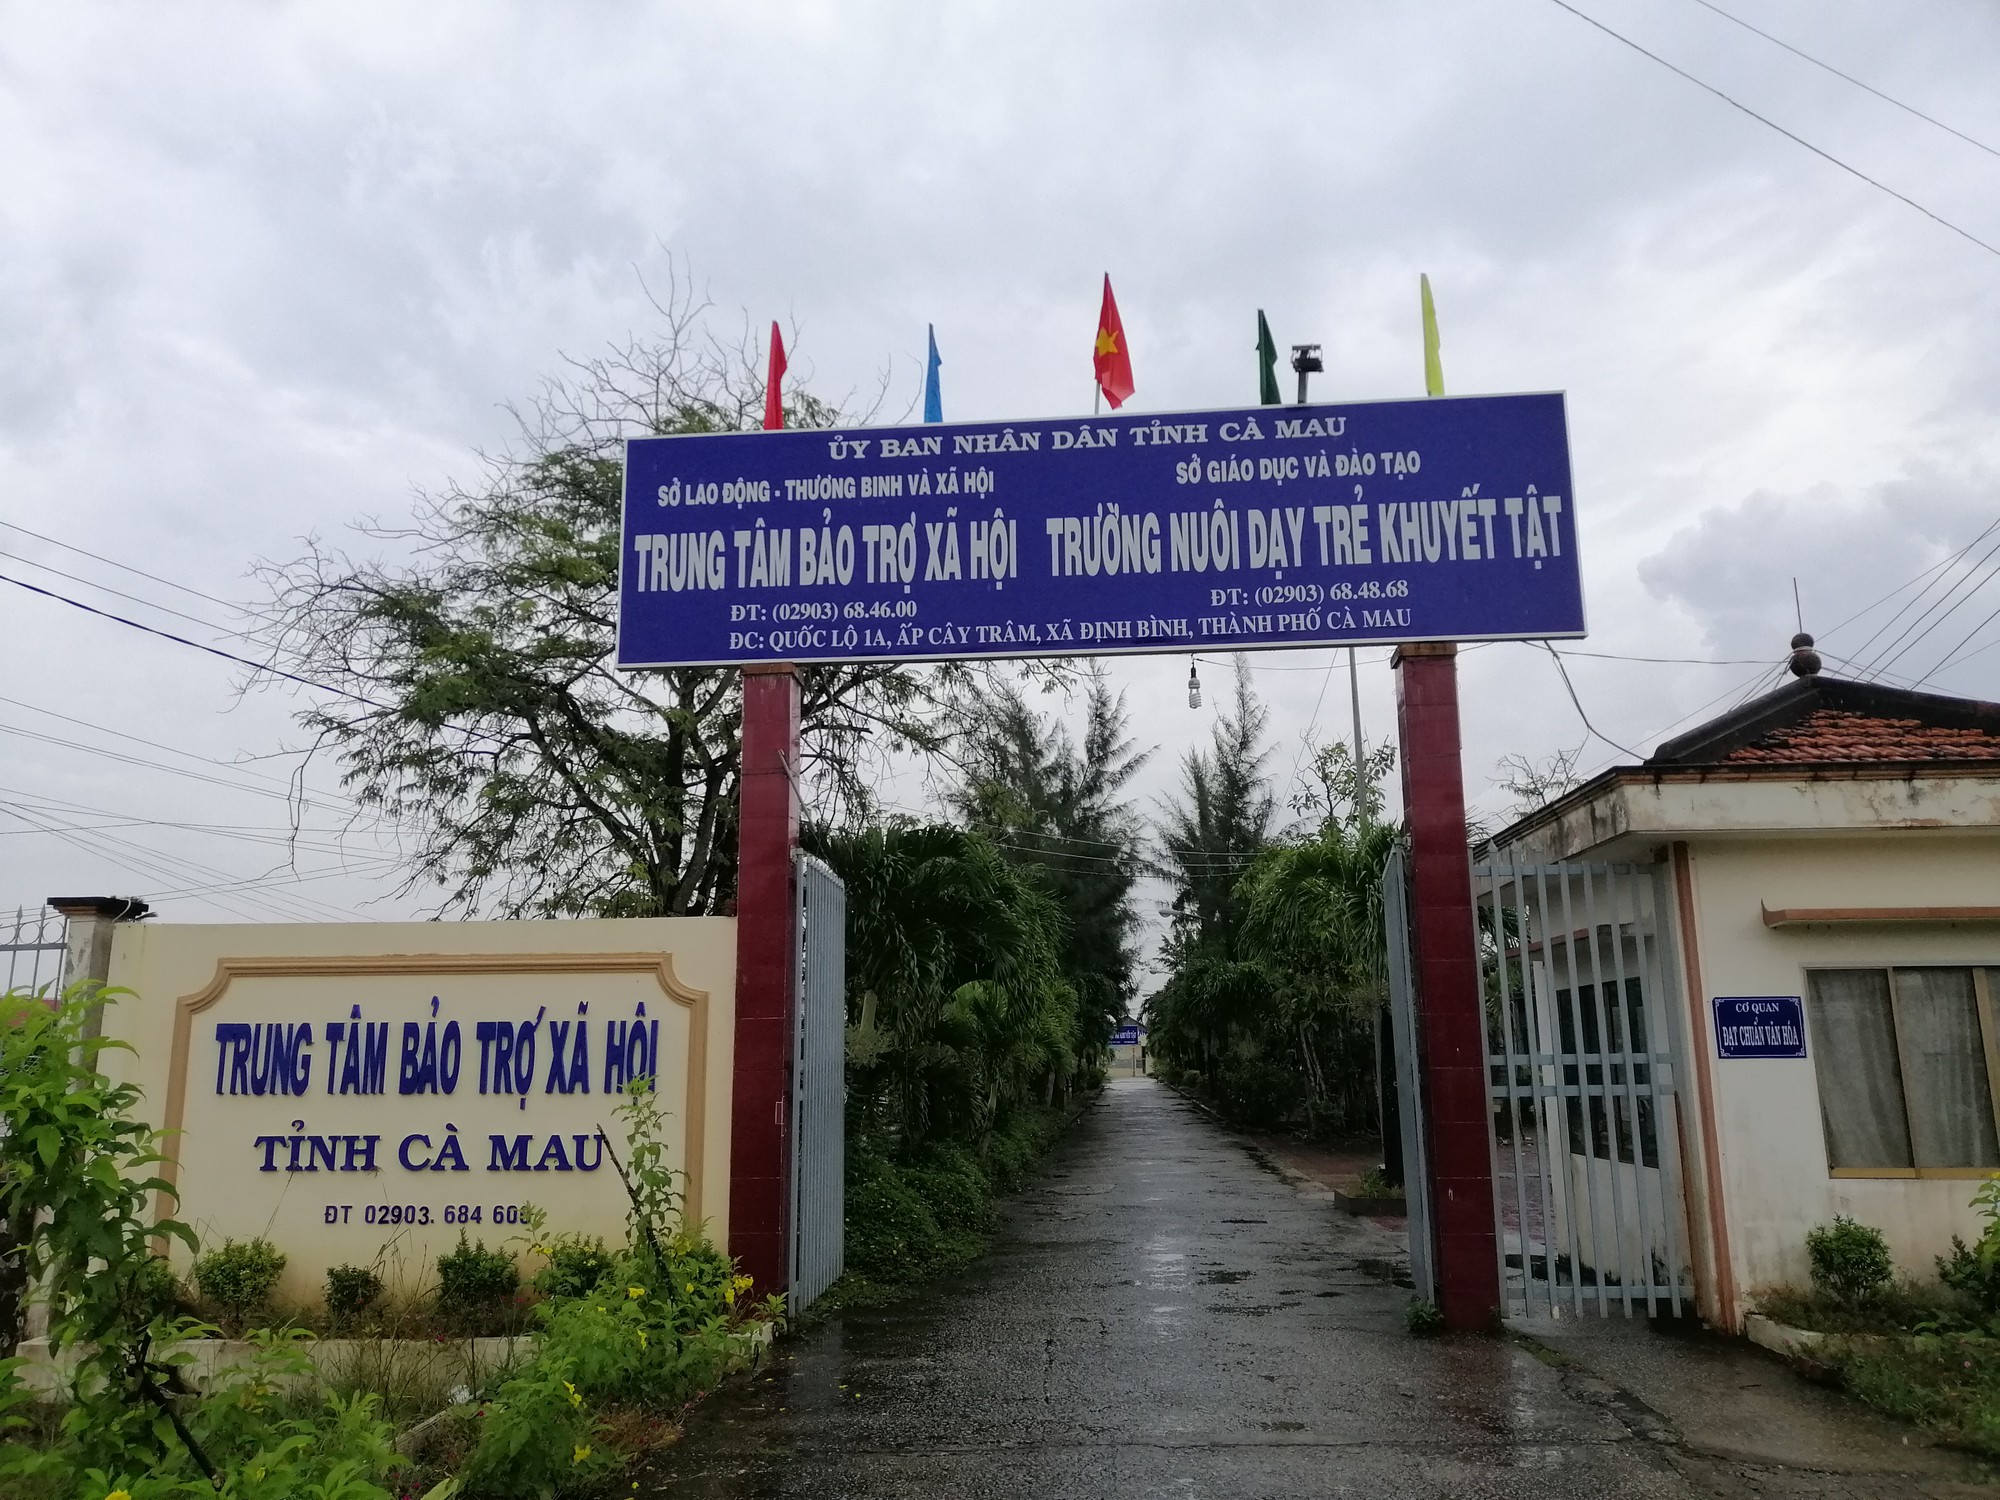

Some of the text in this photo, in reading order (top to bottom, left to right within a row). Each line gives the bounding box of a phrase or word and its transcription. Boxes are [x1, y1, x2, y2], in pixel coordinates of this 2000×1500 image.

[828, 416, 1348, 461] ỦY BAN NHÂN DÂN TỈNH CÀ MAU
[657, 476, 681, 508] SỞ
[685, 482, 719, 506] LAO
[722, 477, 771, 510] ĐỘNG
[784, 473, 856, 501] THƯƠNG
[860, 474, 903, 498] BINH
[907, 467, 932, 496] VÀ
[935, 466, 960, 495] XÃ
[964, 466, 994, 500] HỘI
[1176, 447, 1421, 486] SỞ GIÁO DỤC VÀ ĐÀO TẠO
[634, 506, 1017, 594] TRUNG TÂM BẢO TRỢ XÃ HỘI
[1046, 483, 1562, 580] TRƯỜNG NUÔI DẠY TRẺ KHUYẾT TẬT
[730, 600, 917, 624] ĐT: (02903) 68.46.00
[1210, 579, 1409, 607] ĐT: (02903) 68.48.68
[729, 605, 1411, 652] ĐC: QUỐC LỘ 1A, ẤP CÂY TRÂM, XÃ ĐỊNH BÌNH, THÀNH PHỐ CÀ MAU
[1735, 1001, 1779, 1014] CƠ QUAN
[215, 996, 659, 1110] TRUNG TÂM BẢO TRỢ XÃ HỘI
[1722, 1016, 1799, 1051] ĐẠT CHUẨN VĂN HÓA
[253, 1119, 604, 1172] TỈNH CÀ MAU
[324, 1205, 353, 1224] ĐT
[364, 1205, 434, 1225] 02903.
[444, 1205, 482, 1224] 684
